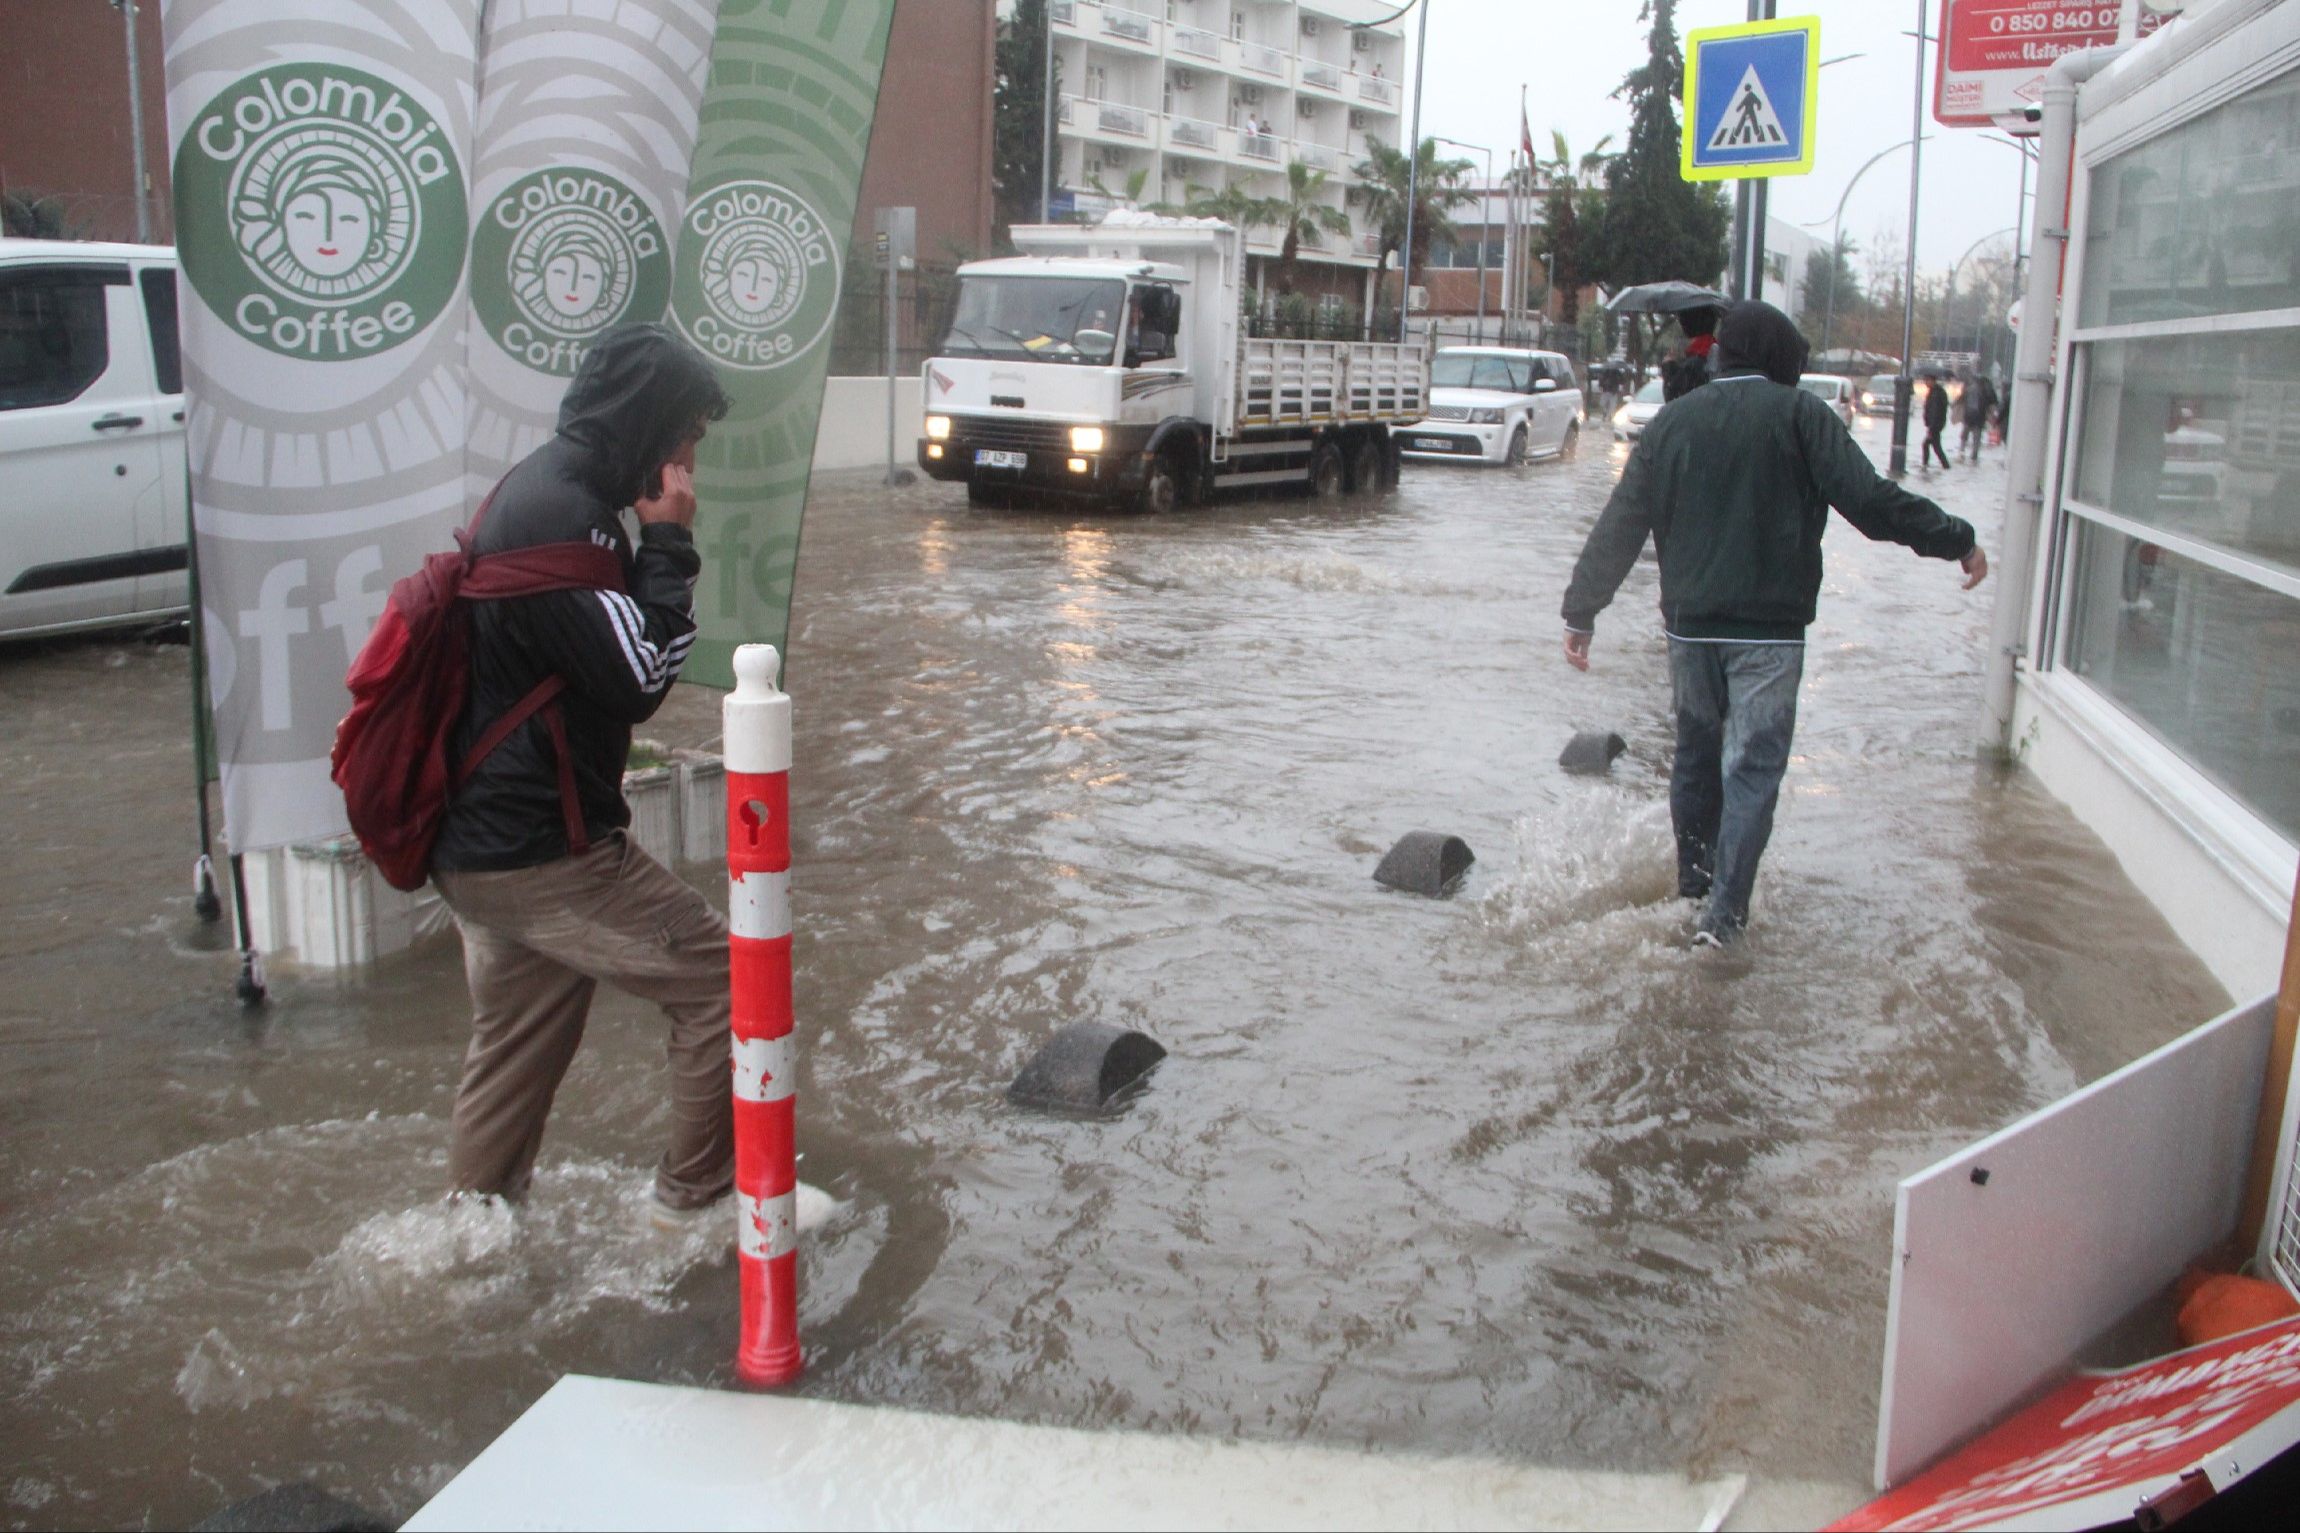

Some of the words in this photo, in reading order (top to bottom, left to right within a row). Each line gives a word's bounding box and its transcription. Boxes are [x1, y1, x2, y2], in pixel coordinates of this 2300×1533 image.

[1990, 17, 2005, 32] 0
[2009, 14, 2048, 31] 850
[2052, 11, 2093, 29] 840
[198, 76, 449, 186] Colombia
[496, 174, 660, 259] Colombia
[692, 190, 827, 266] Colombia
[236, 293, 416, 354] Coffee
[503, 322, 593, 373] Coff
[693, 315, 793, 362] Coffee
